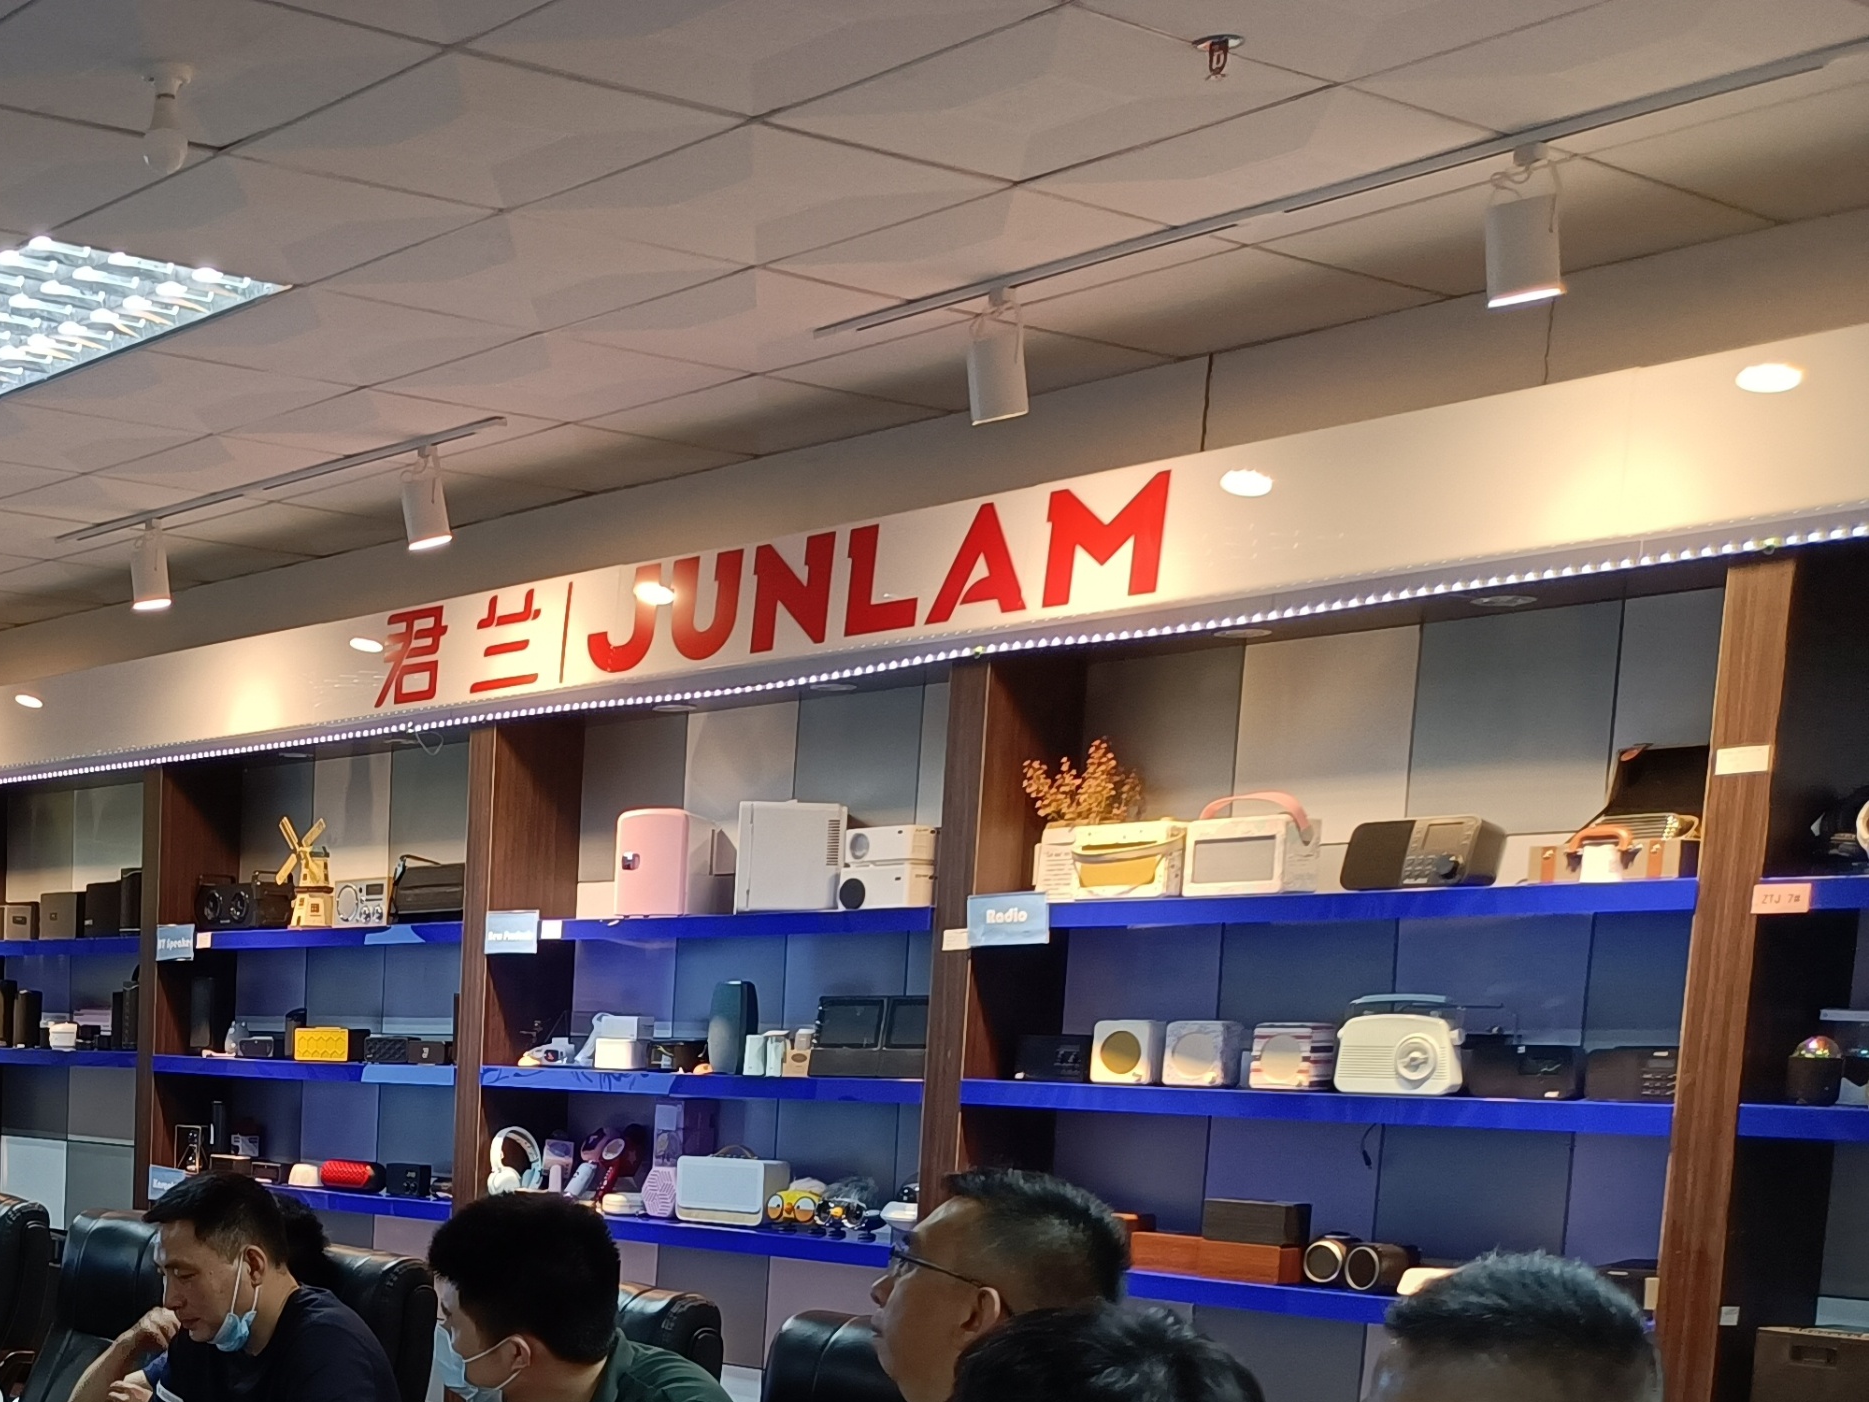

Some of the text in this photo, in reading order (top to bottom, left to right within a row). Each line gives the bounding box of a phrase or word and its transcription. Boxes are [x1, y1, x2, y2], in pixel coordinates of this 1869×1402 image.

[586, 467, 1176, 676] JUNLAM
[1761, 894, 1782, 904] ZTJ
[986, 907, 1028, 924] Radio
